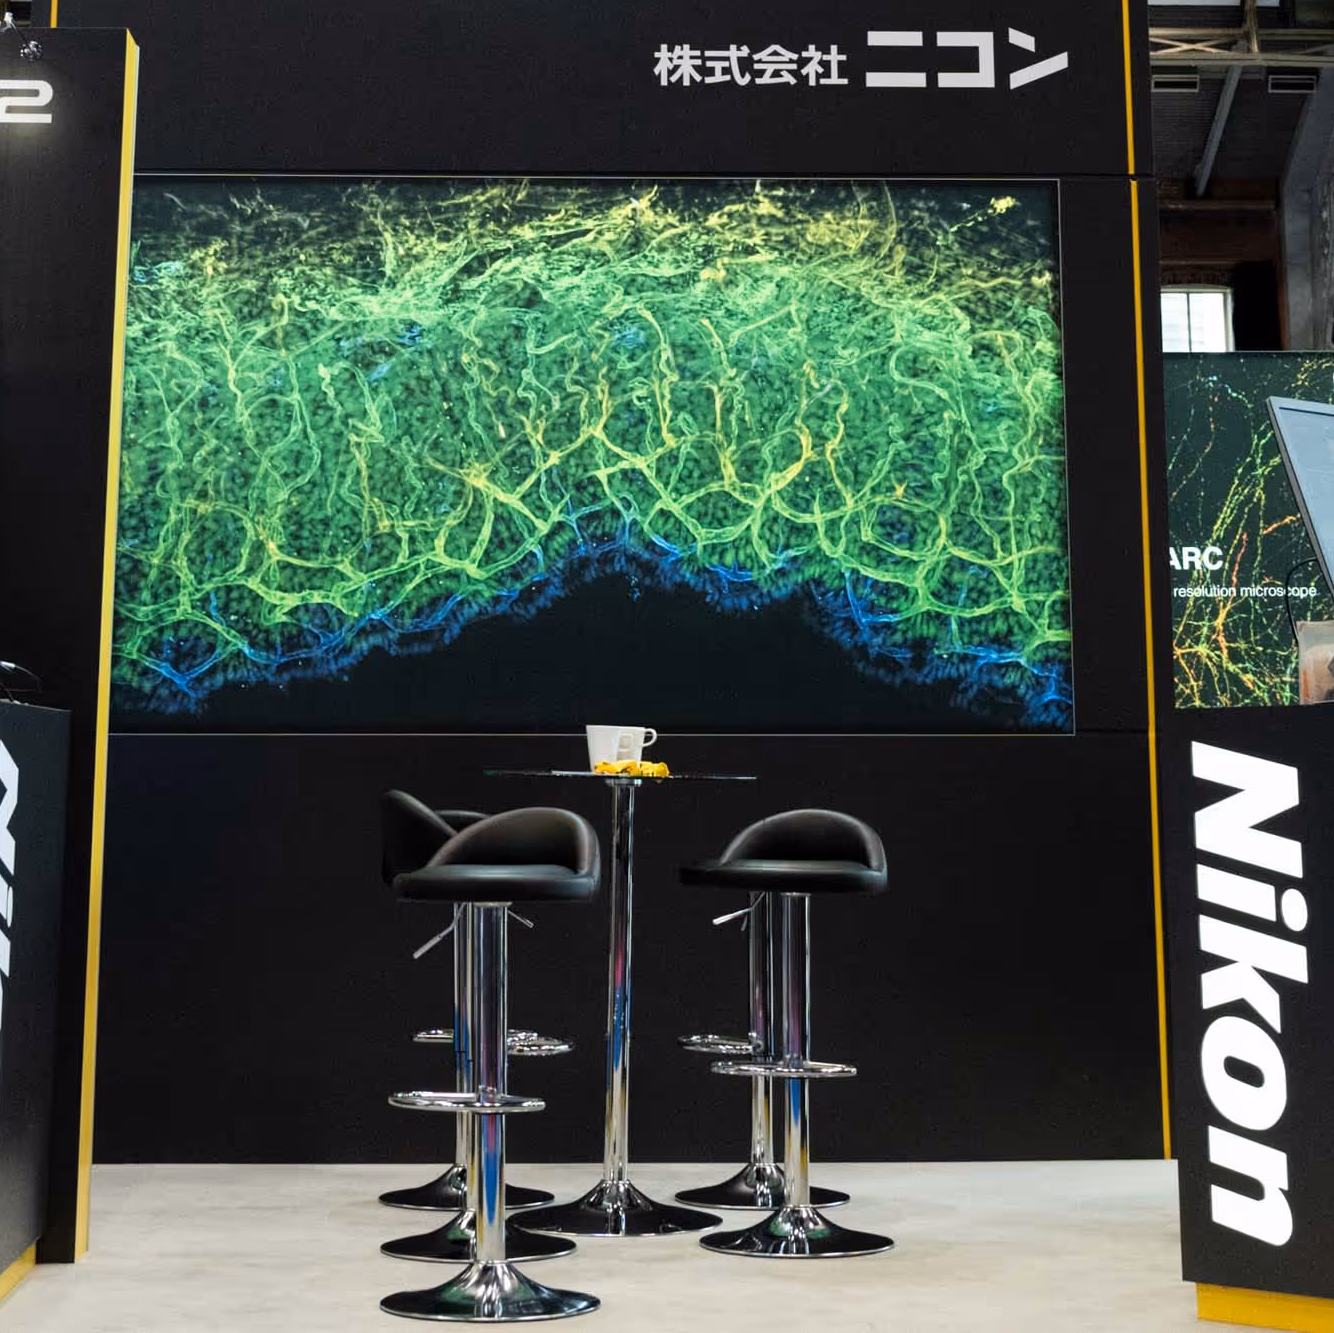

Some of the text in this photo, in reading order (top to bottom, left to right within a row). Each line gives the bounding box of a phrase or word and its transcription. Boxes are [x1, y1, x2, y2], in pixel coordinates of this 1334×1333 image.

[654, 28, 1068, 89] 株式会社 ニコン
[1173, 584, 1318, 600] resolution microscope
[1191, 741, 1309, 1247] Nikon
